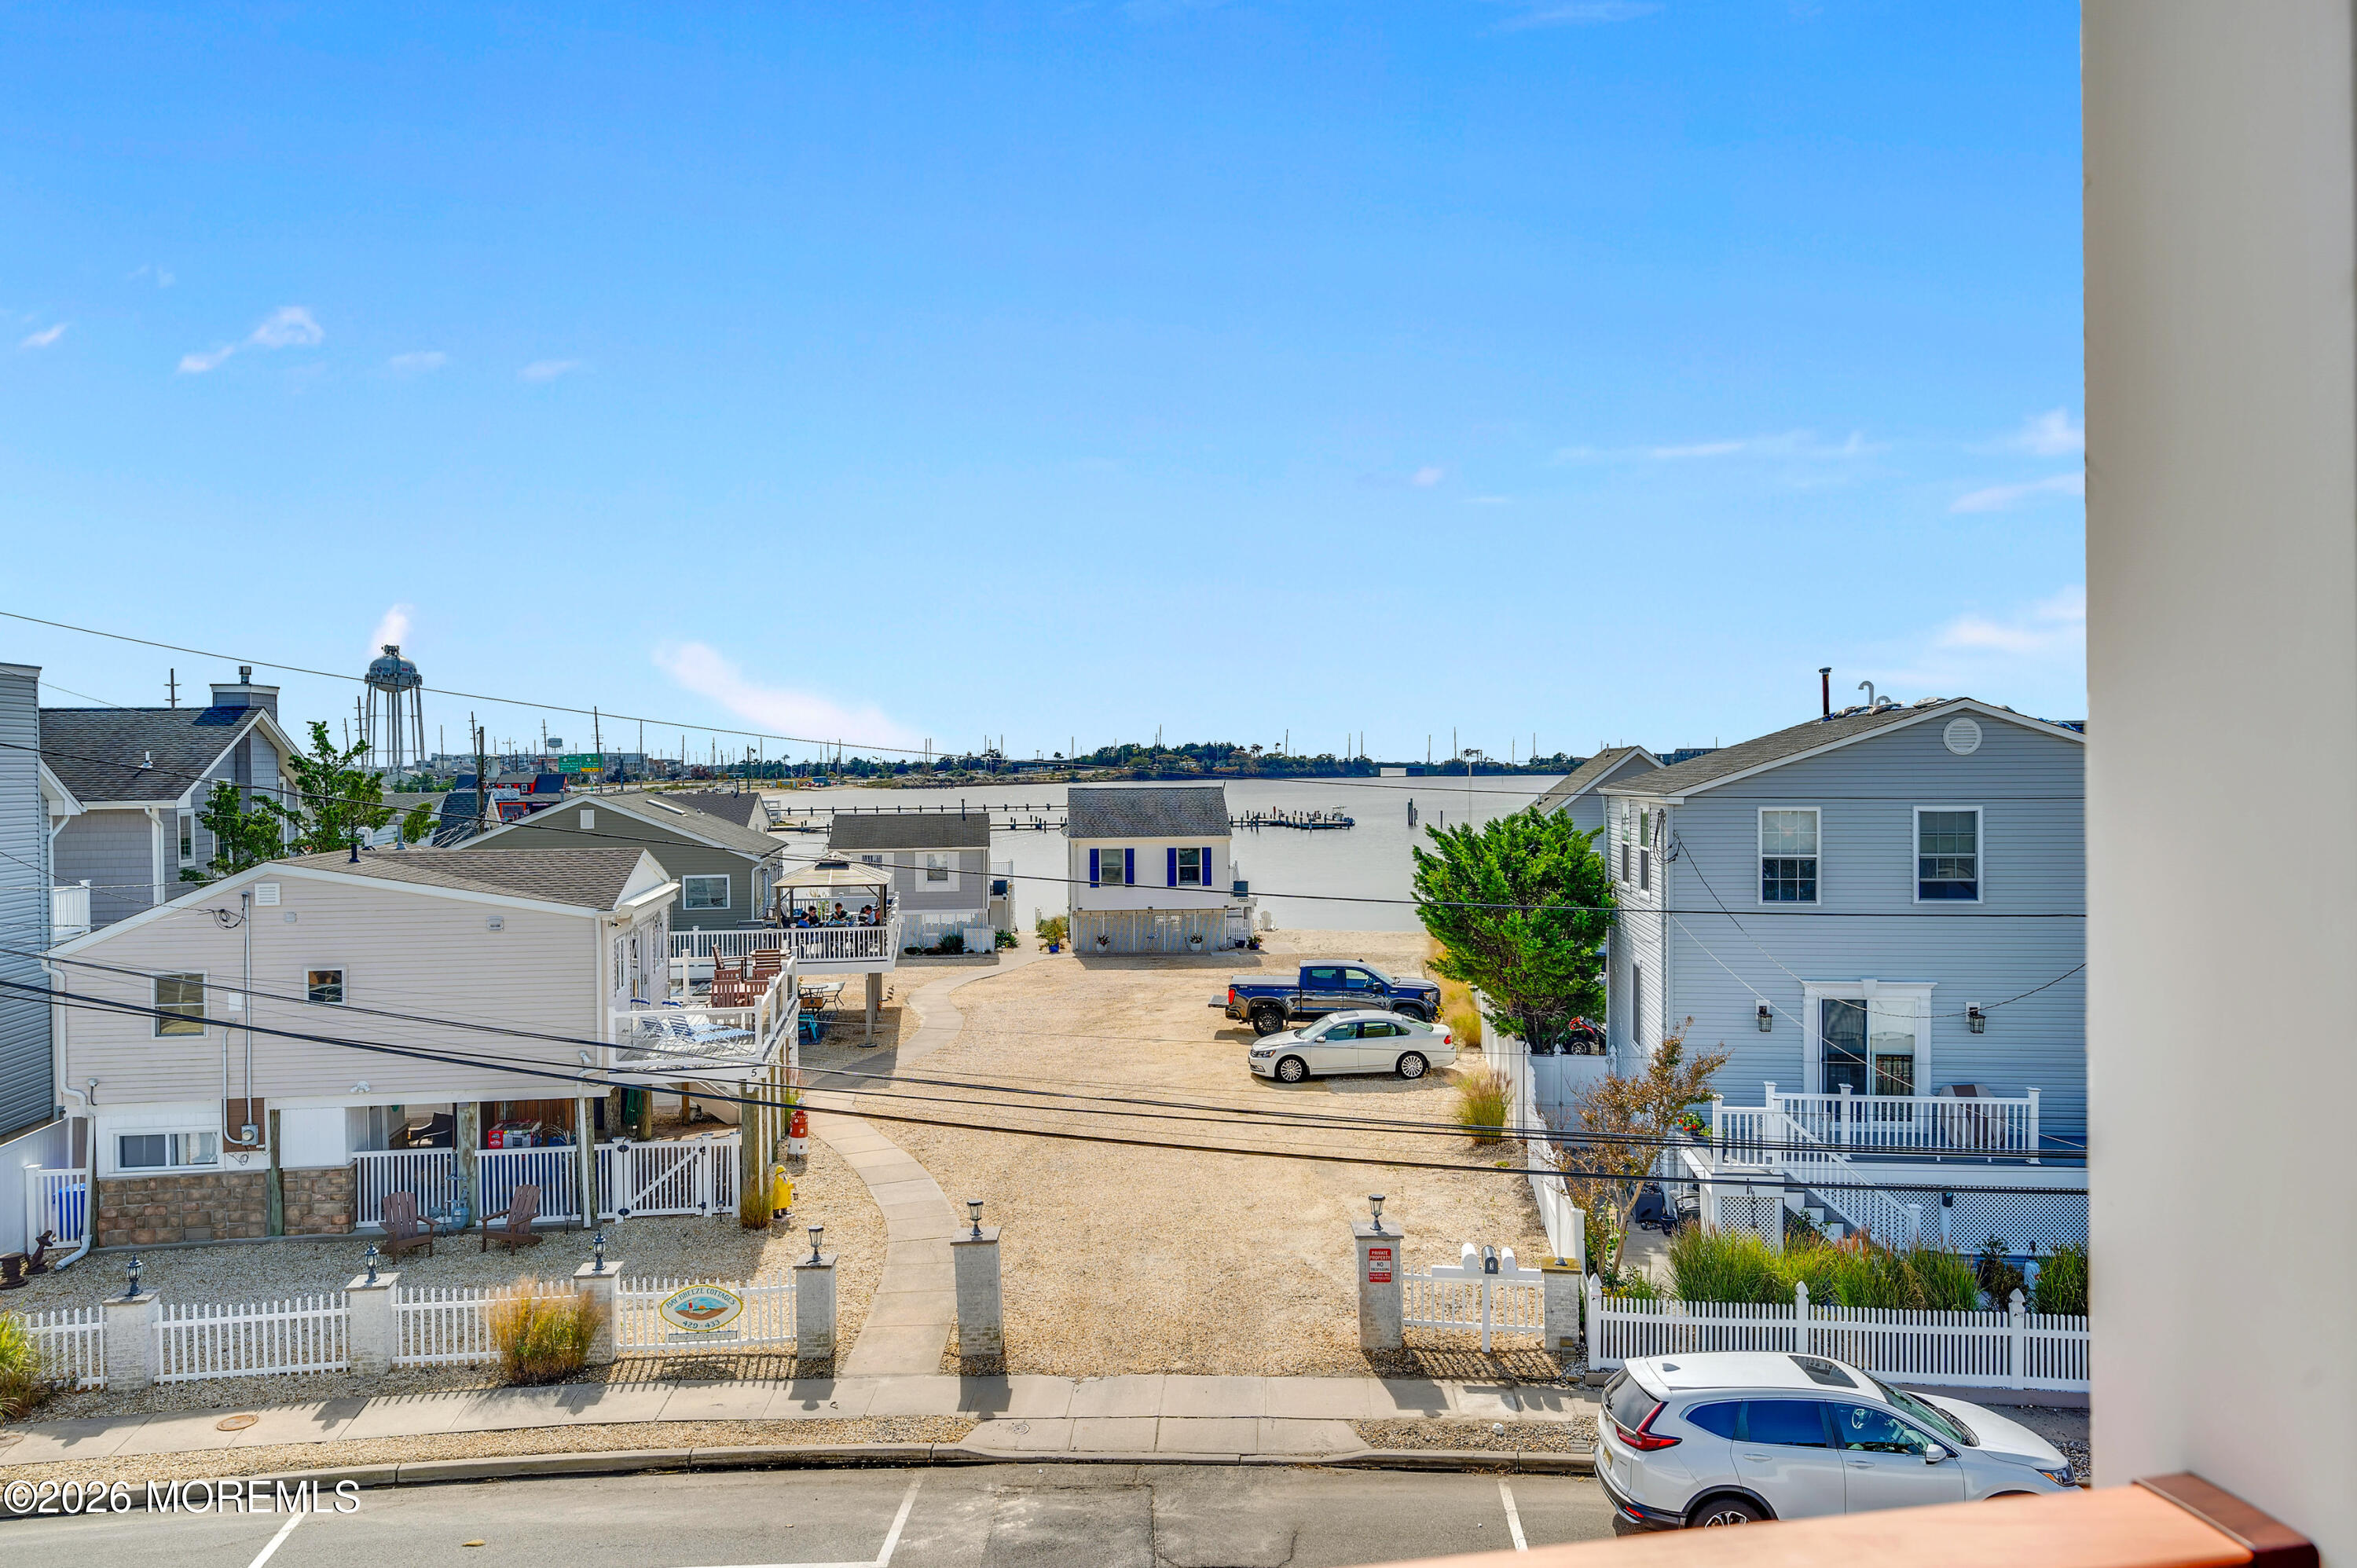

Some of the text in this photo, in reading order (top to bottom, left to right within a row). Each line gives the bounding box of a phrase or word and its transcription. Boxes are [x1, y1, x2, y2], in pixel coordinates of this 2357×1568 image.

[665, 1298, 678, 1308] BAY
[706, 1288, 736, 1305] COTTAGES
[705, 1319, 720, 1328] 433
